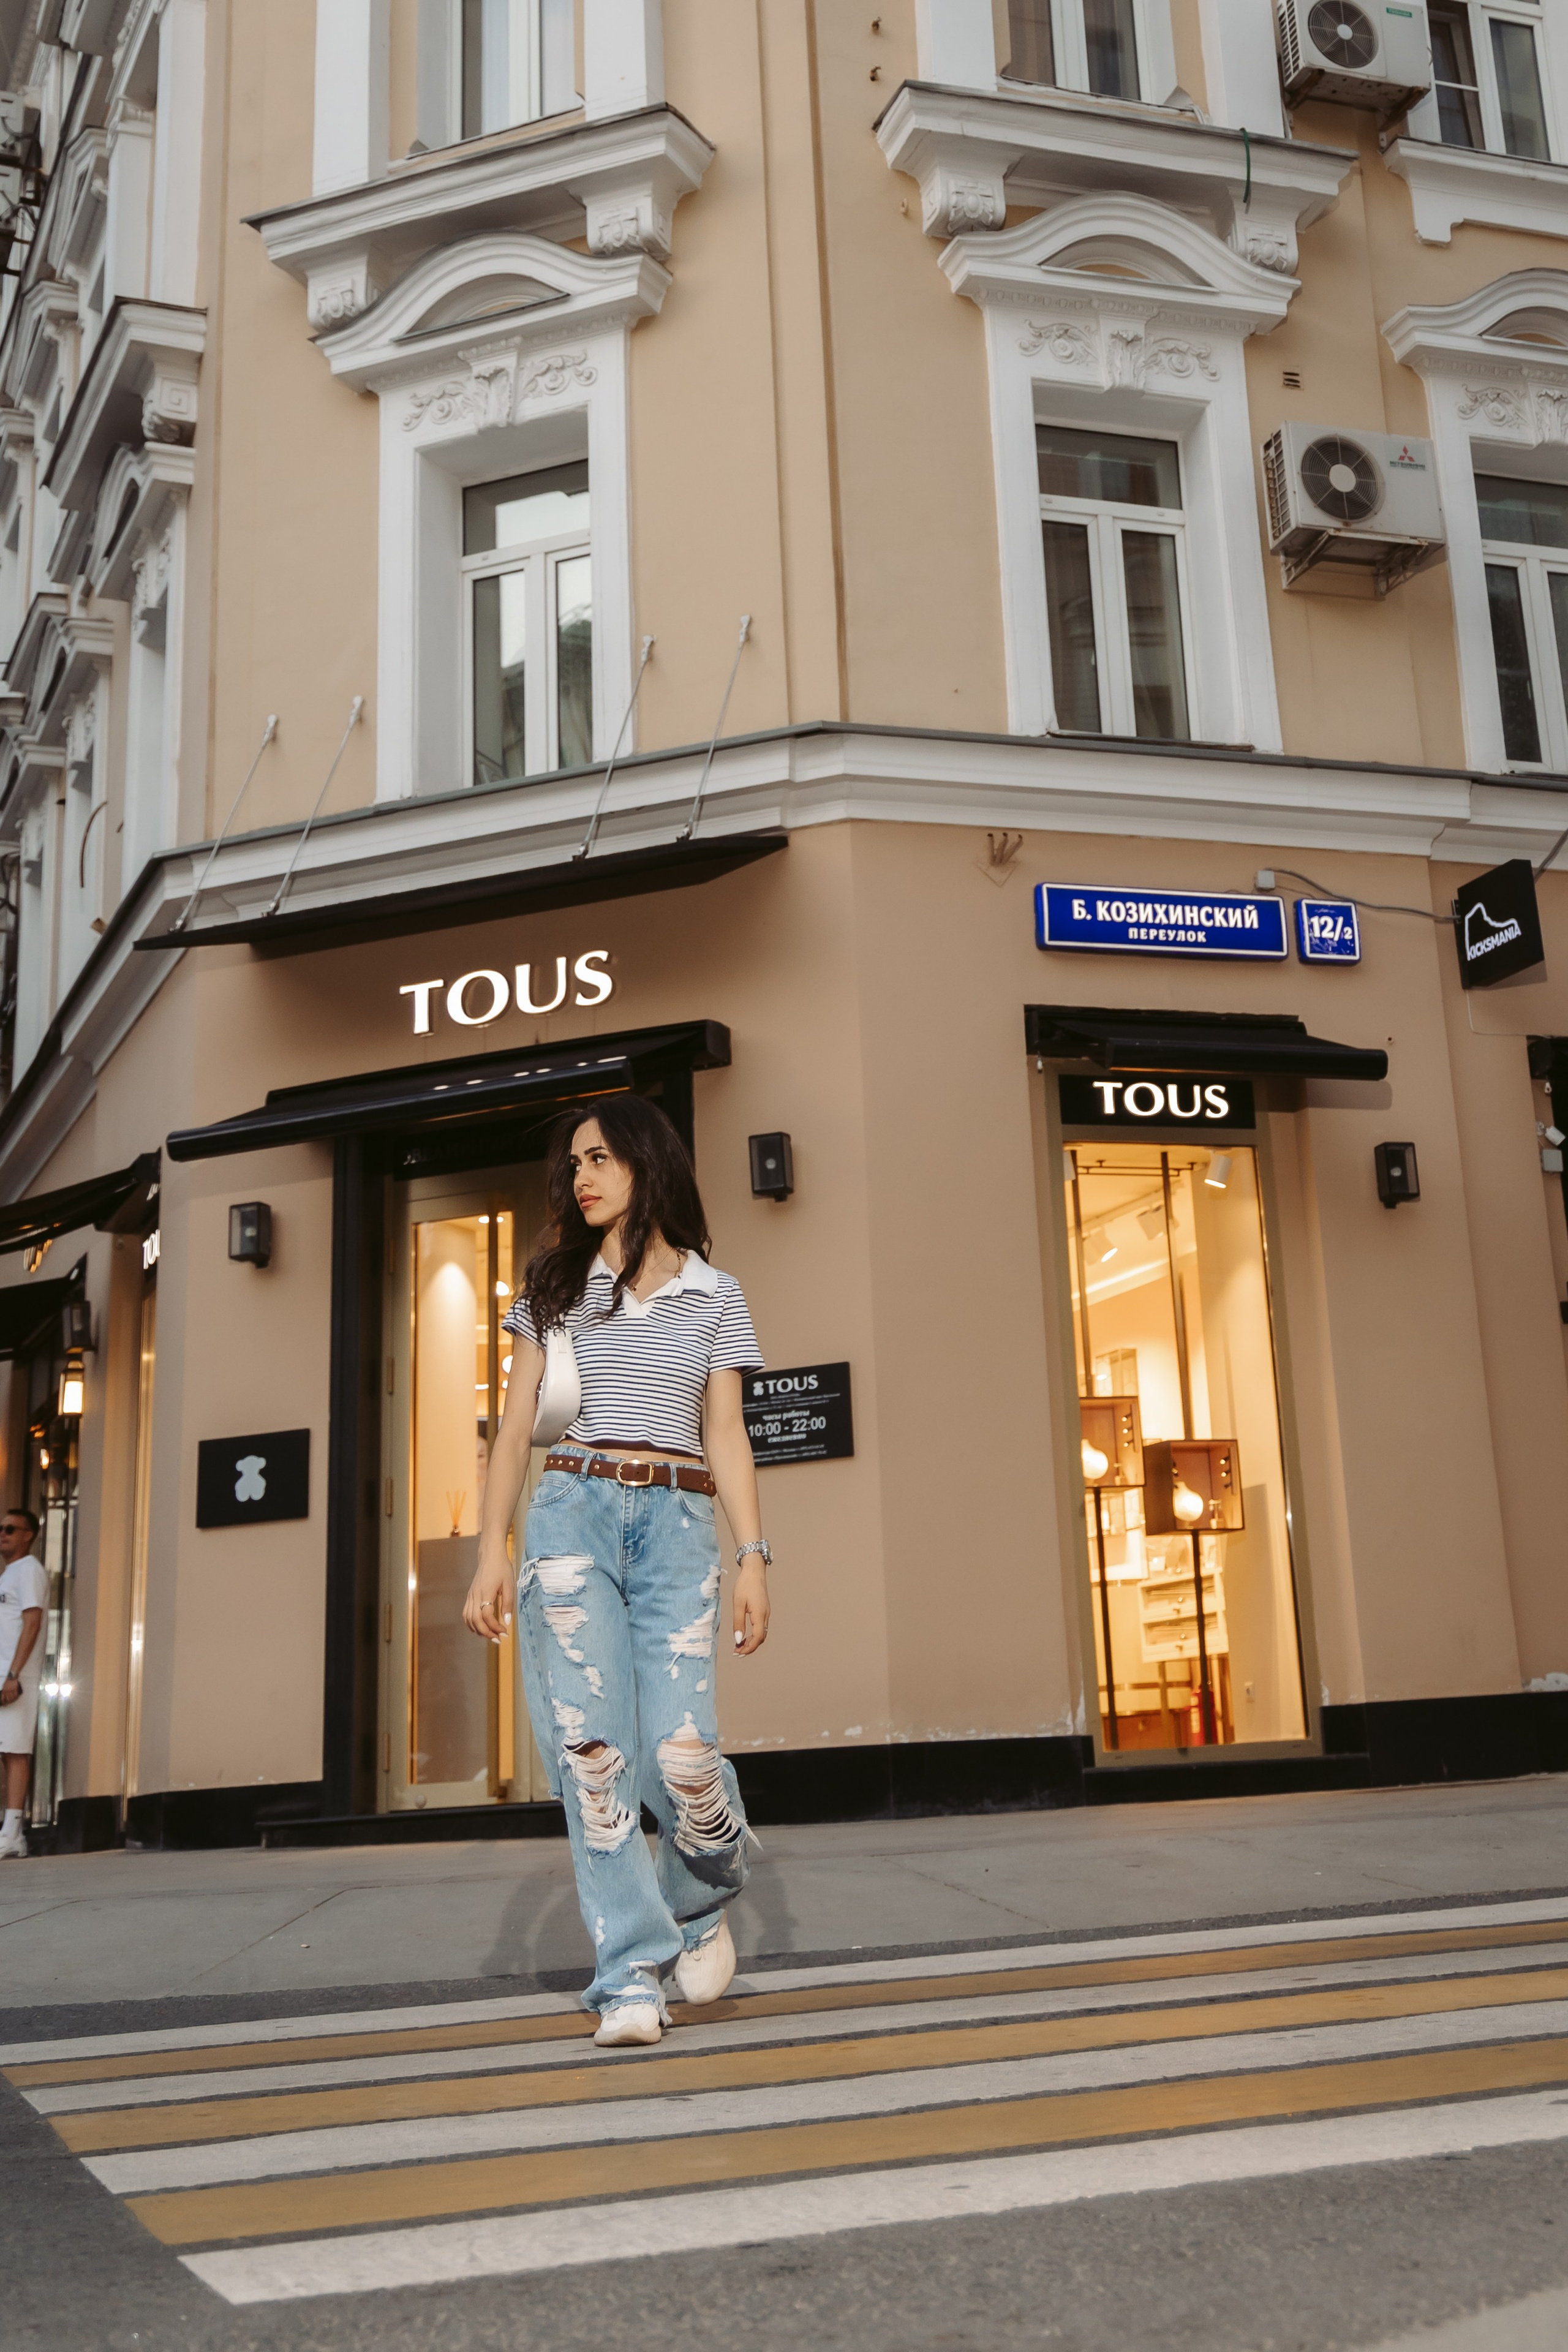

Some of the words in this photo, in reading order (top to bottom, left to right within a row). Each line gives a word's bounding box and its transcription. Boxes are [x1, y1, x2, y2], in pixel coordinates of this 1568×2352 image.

[1072, 899, 1093, 921] Б.
[1096, 900, 1259, 929] КОЗИХИНСКИЙ
[1128, 927, 1207, 943] ПЕРЕУЛОК
[1310, 915, 1353, 941] 12/2
[1467, 925, 1521, 961] KICKSMANIA
[399, 950, 613, 1034] TOUS
[1093, 1081, 1229, 1118] TOUS
[765, 1374, 819, 1395] TOUS
[748, 1422, 781, 1438] 10:00
[792, 1416, 826, 1432] 22:00
[783, 1409, 810, 1421] работы
